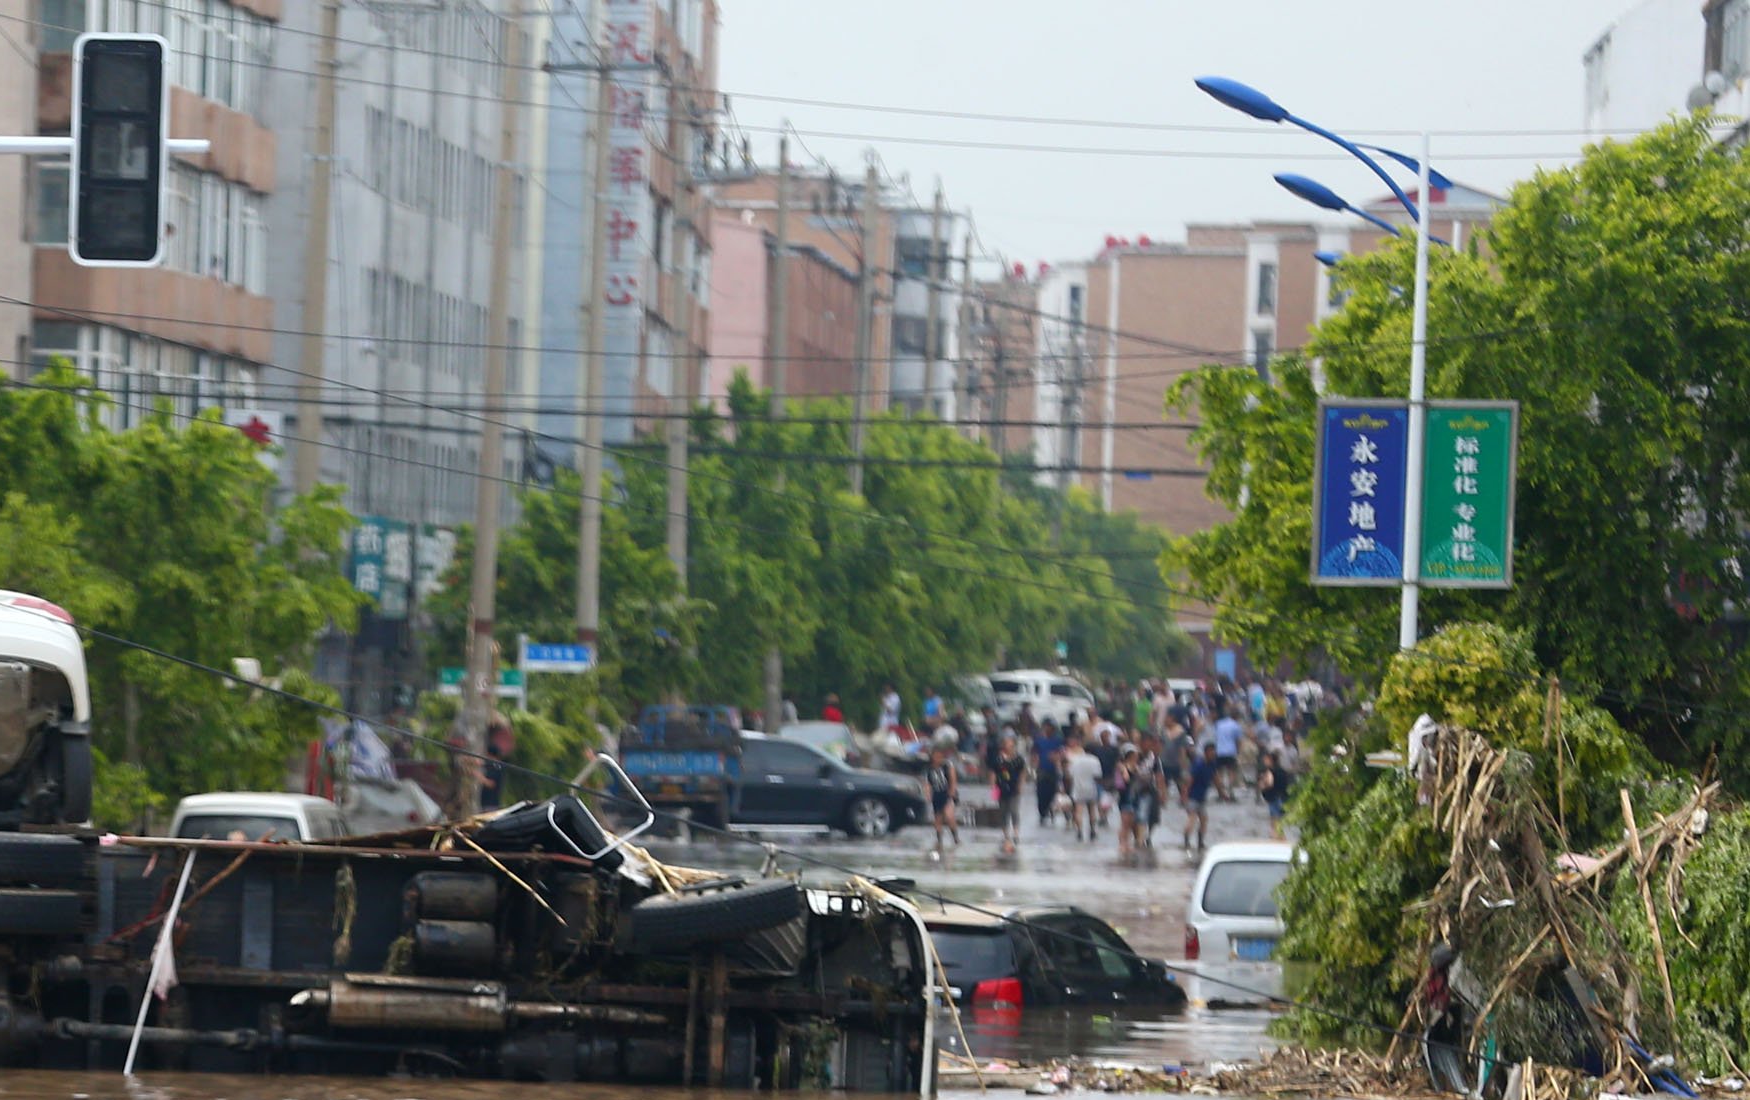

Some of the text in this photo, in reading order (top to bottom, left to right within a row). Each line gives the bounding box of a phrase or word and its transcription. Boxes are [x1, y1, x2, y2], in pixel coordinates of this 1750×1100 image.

[1453, 435, 1480, 495] 标准化
[1347, 433, 1379, 562] 永安地产
[1452, 502, 1477, 562] 专业化
